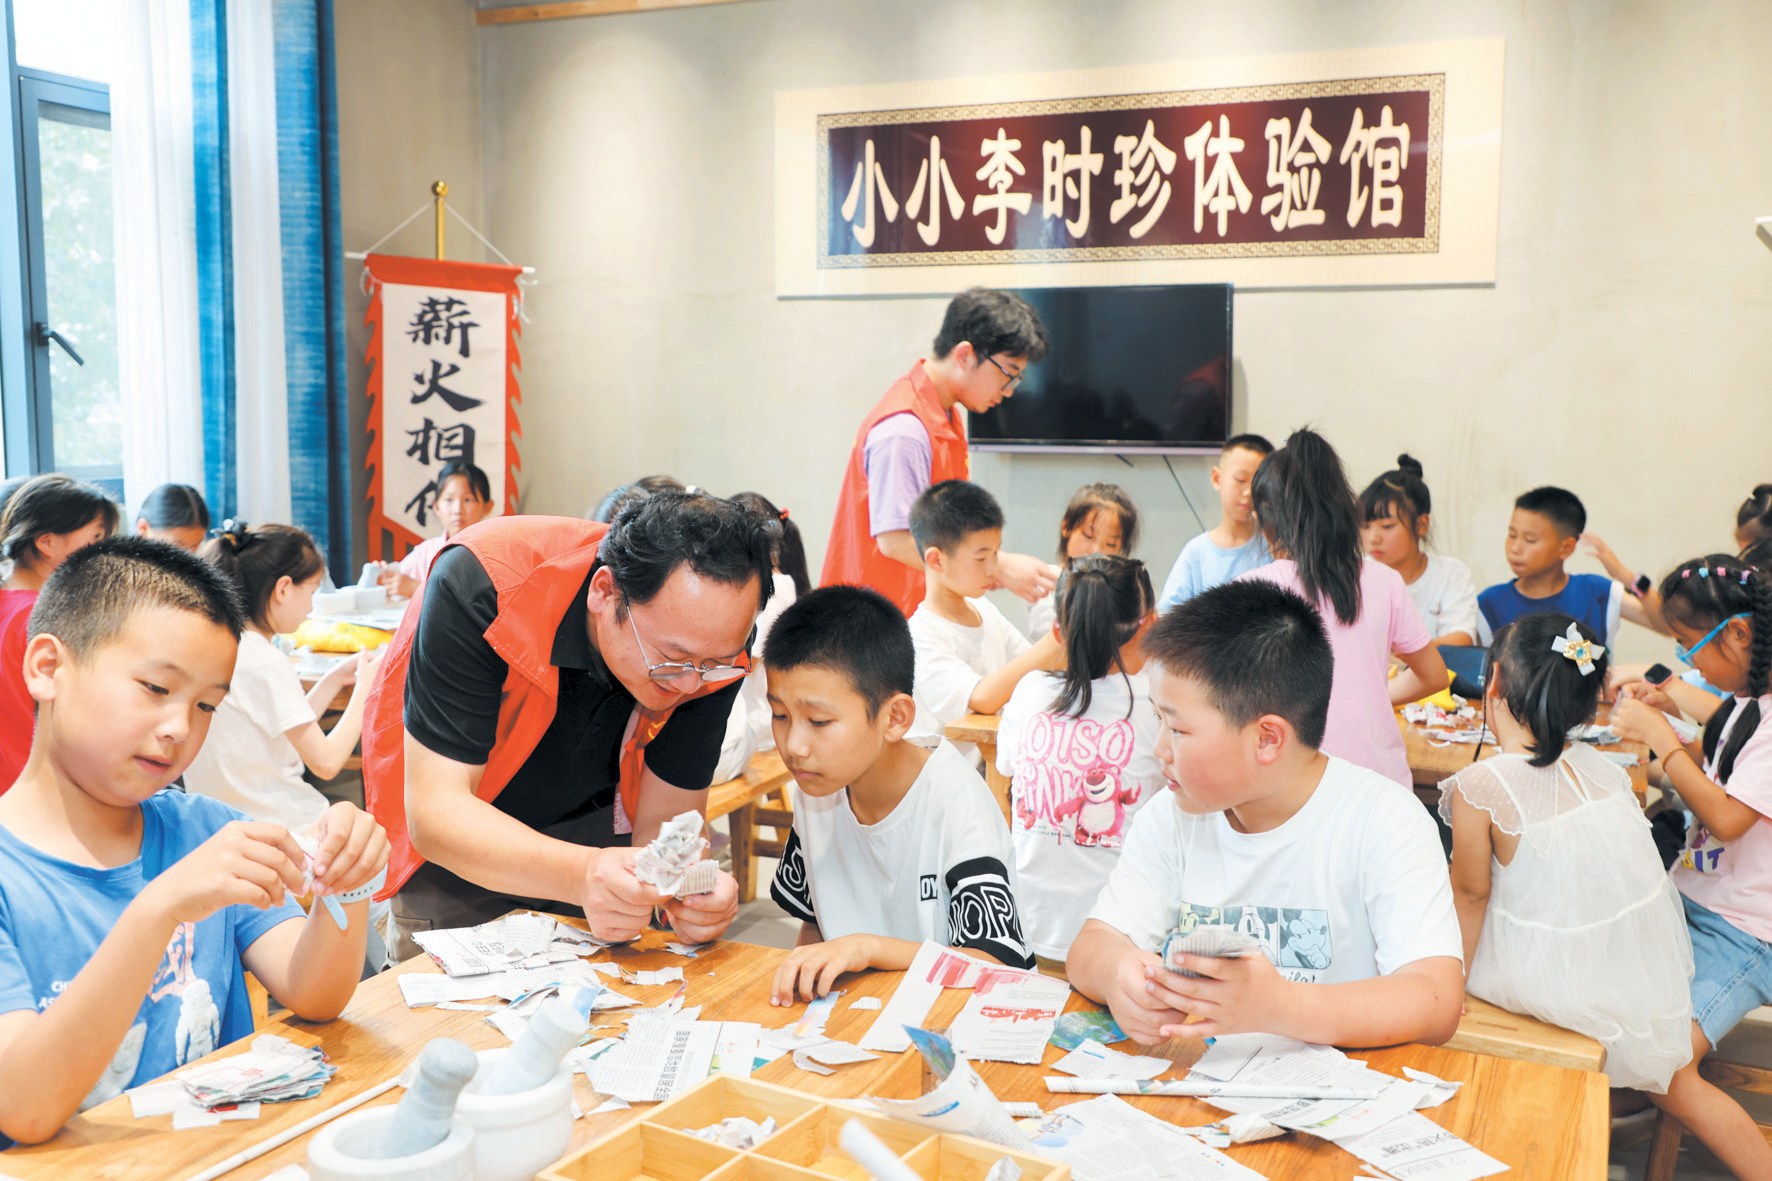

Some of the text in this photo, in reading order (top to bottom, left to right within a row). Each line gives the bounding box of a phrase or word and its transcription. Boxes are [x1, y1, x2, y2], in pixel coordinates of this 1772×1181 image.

[841, 104, 1411, 248] 小小李时珍体验馆
